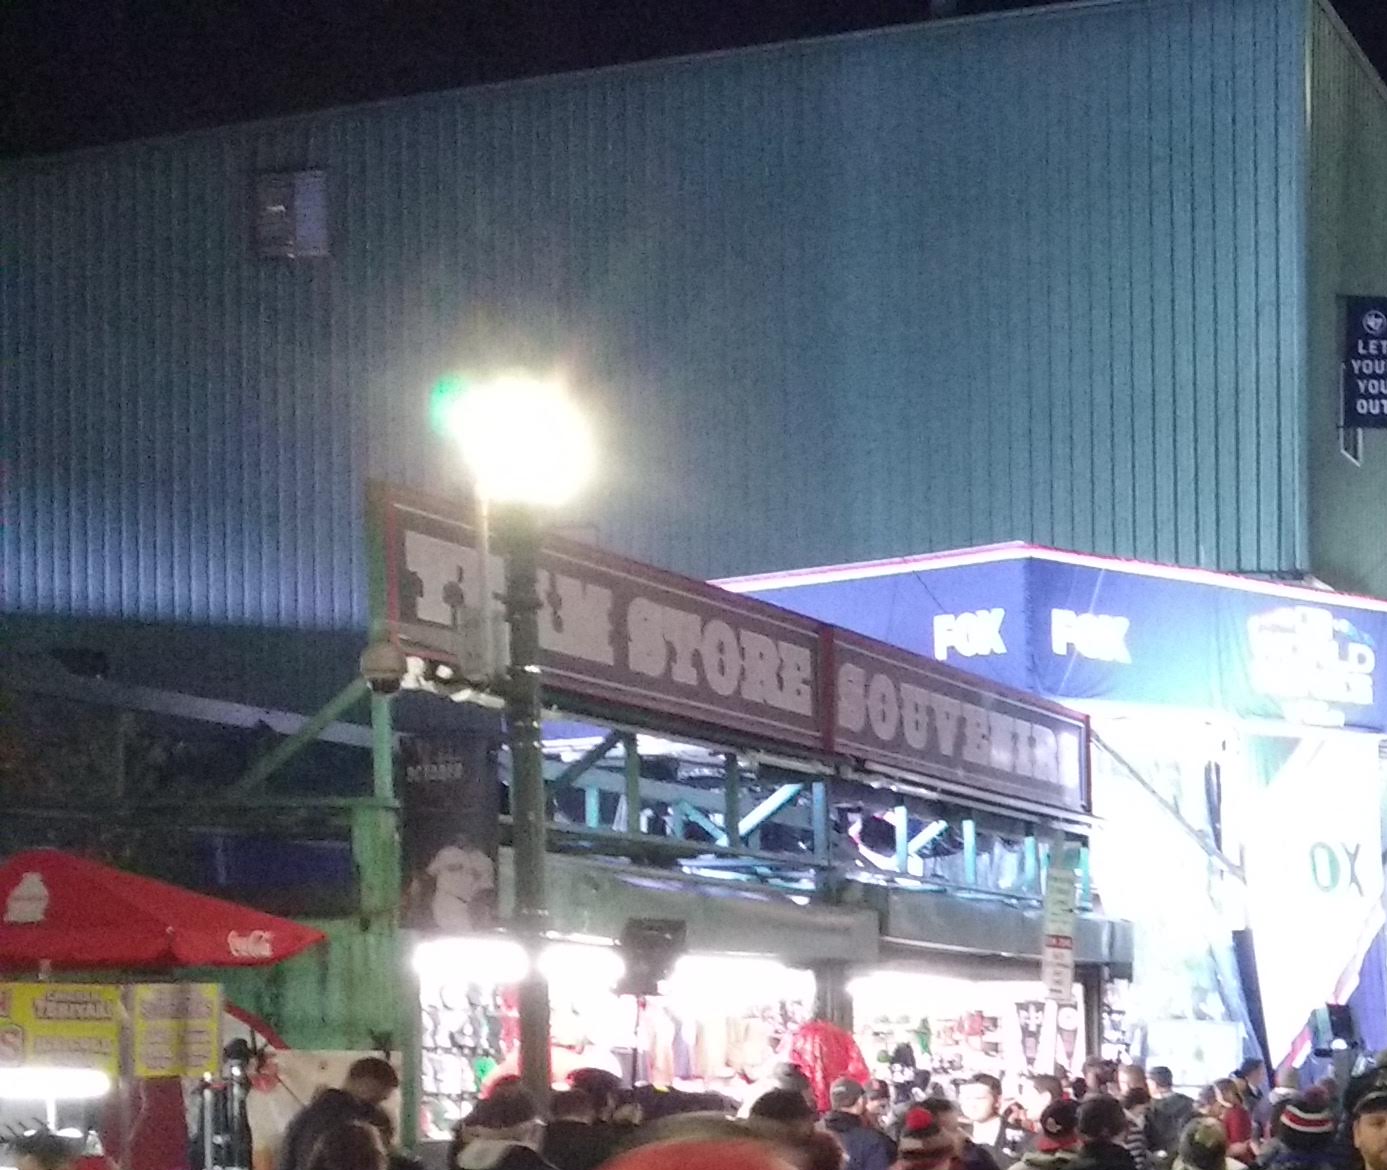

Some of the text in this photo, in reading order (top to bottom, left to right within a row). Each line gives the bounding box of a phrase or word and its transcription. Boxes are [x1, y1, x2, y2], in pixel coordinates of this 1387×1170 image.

[627, 596, 813, 718] STORE
[932, 607, 1007, 661] FOX
[1051, 607, 1131, 664] FOX
